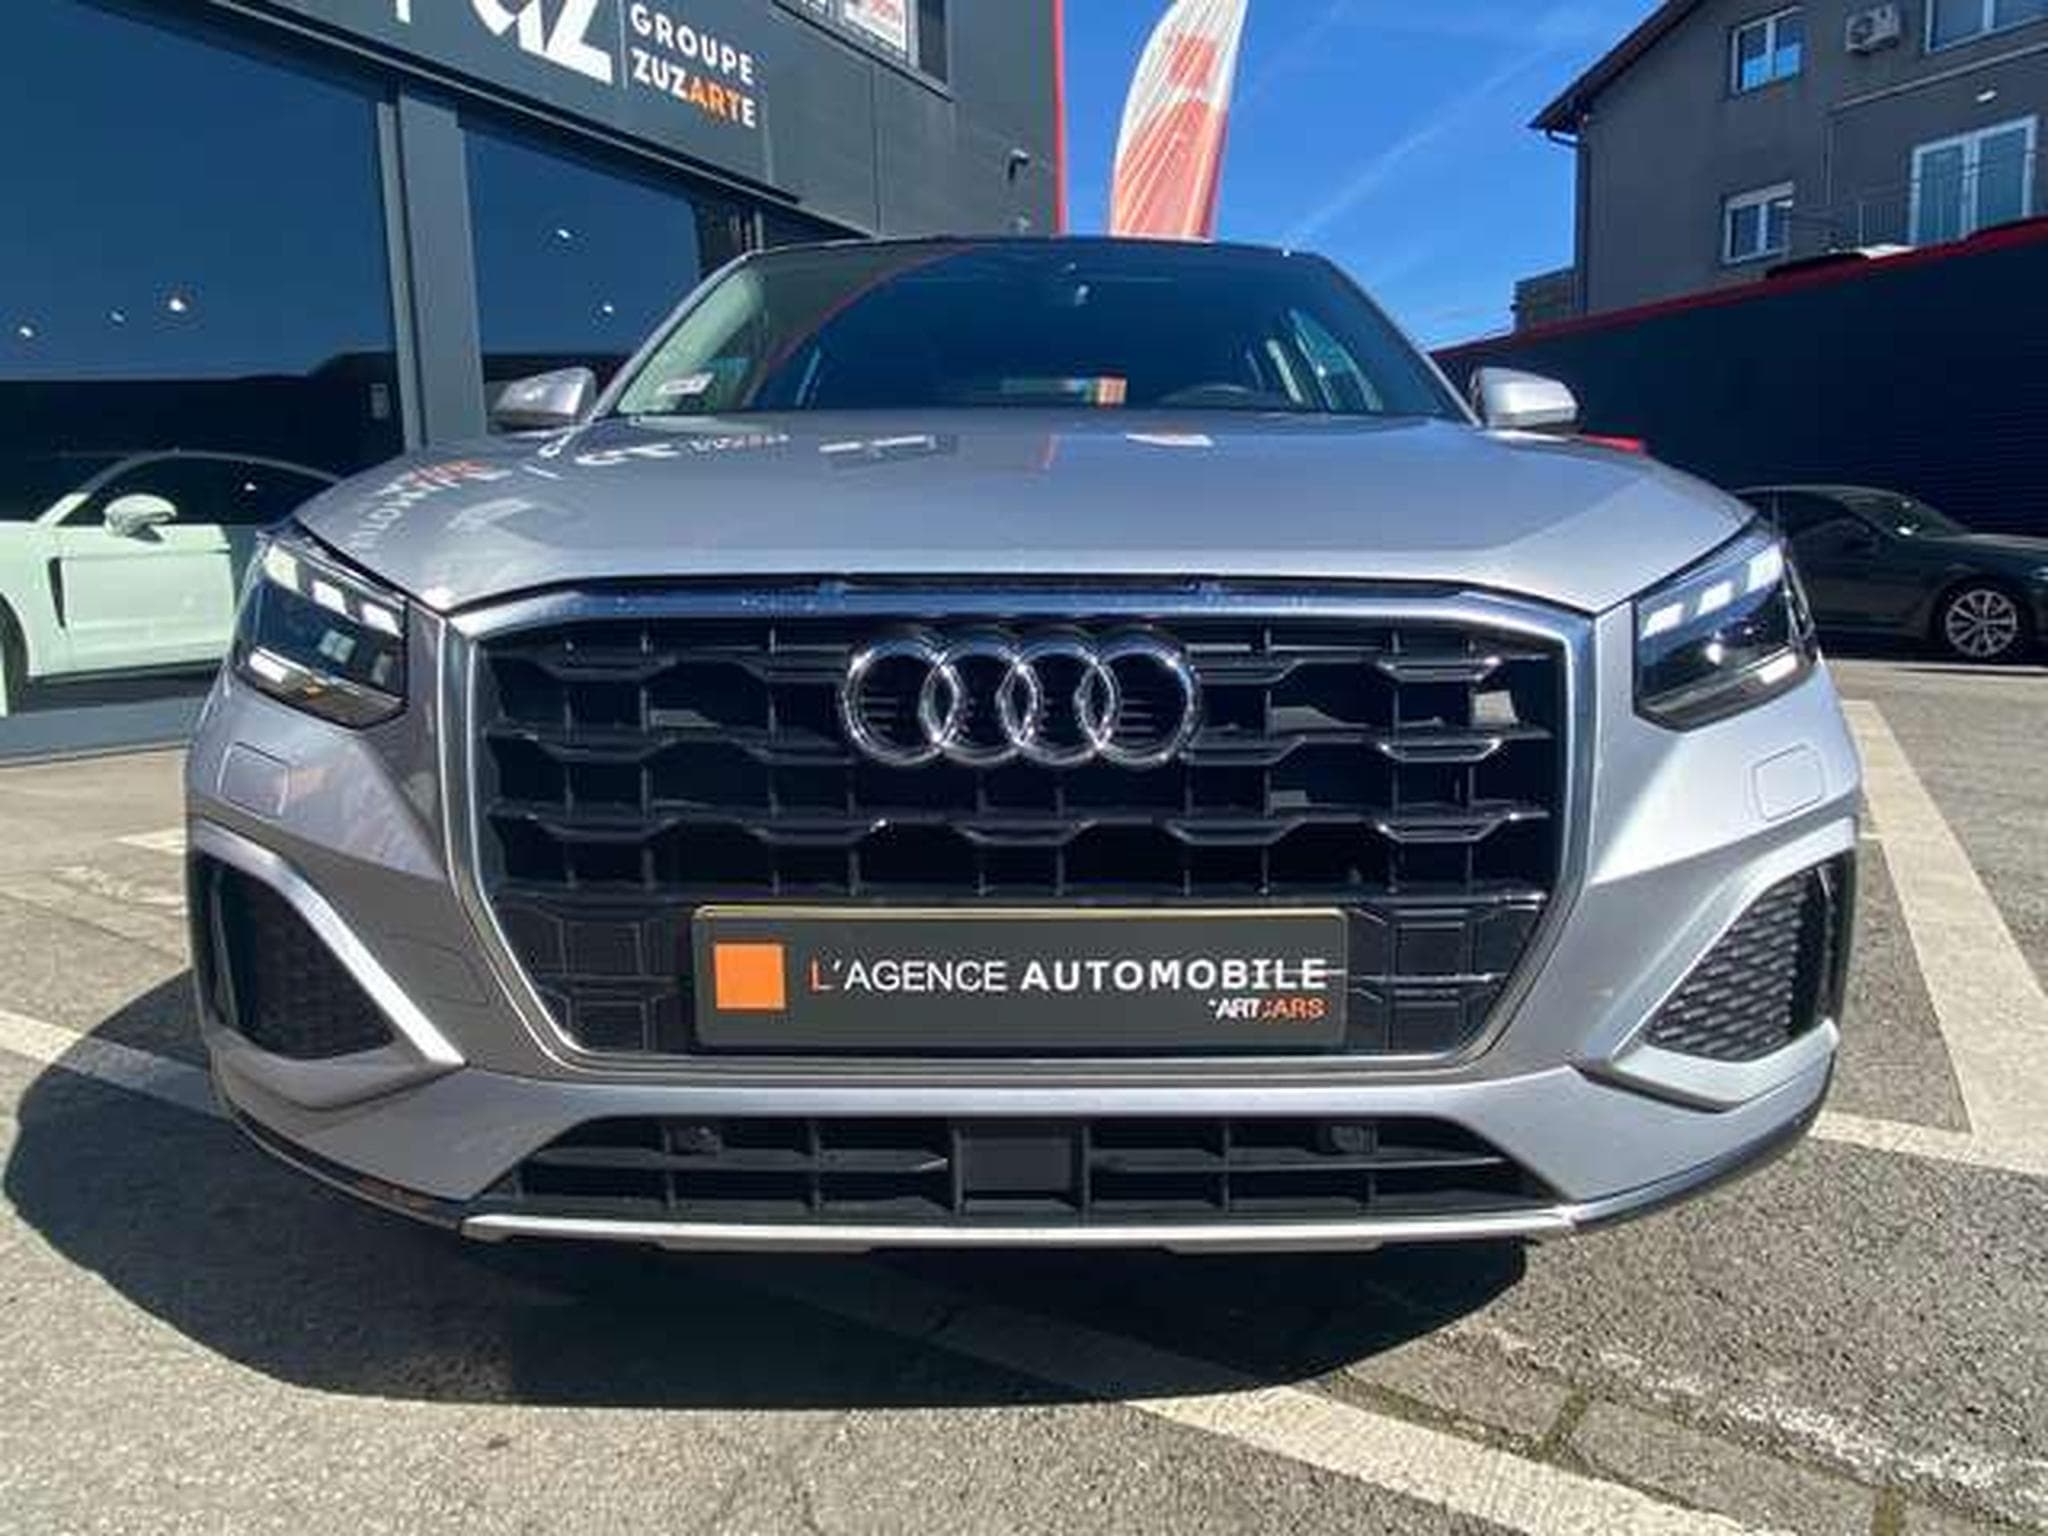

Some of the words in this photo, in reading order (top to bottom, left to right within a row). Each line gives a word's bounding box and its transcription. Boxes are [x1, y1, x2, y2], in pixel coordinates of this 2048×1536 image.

[630, 3, 754, 85] GROUPE
[631, 49, 756, 128] ZUZARTE
[810, 958, 1007, 992] L'AGENCE
[1020, 957, 1328, 991] AUTOMOBILE
